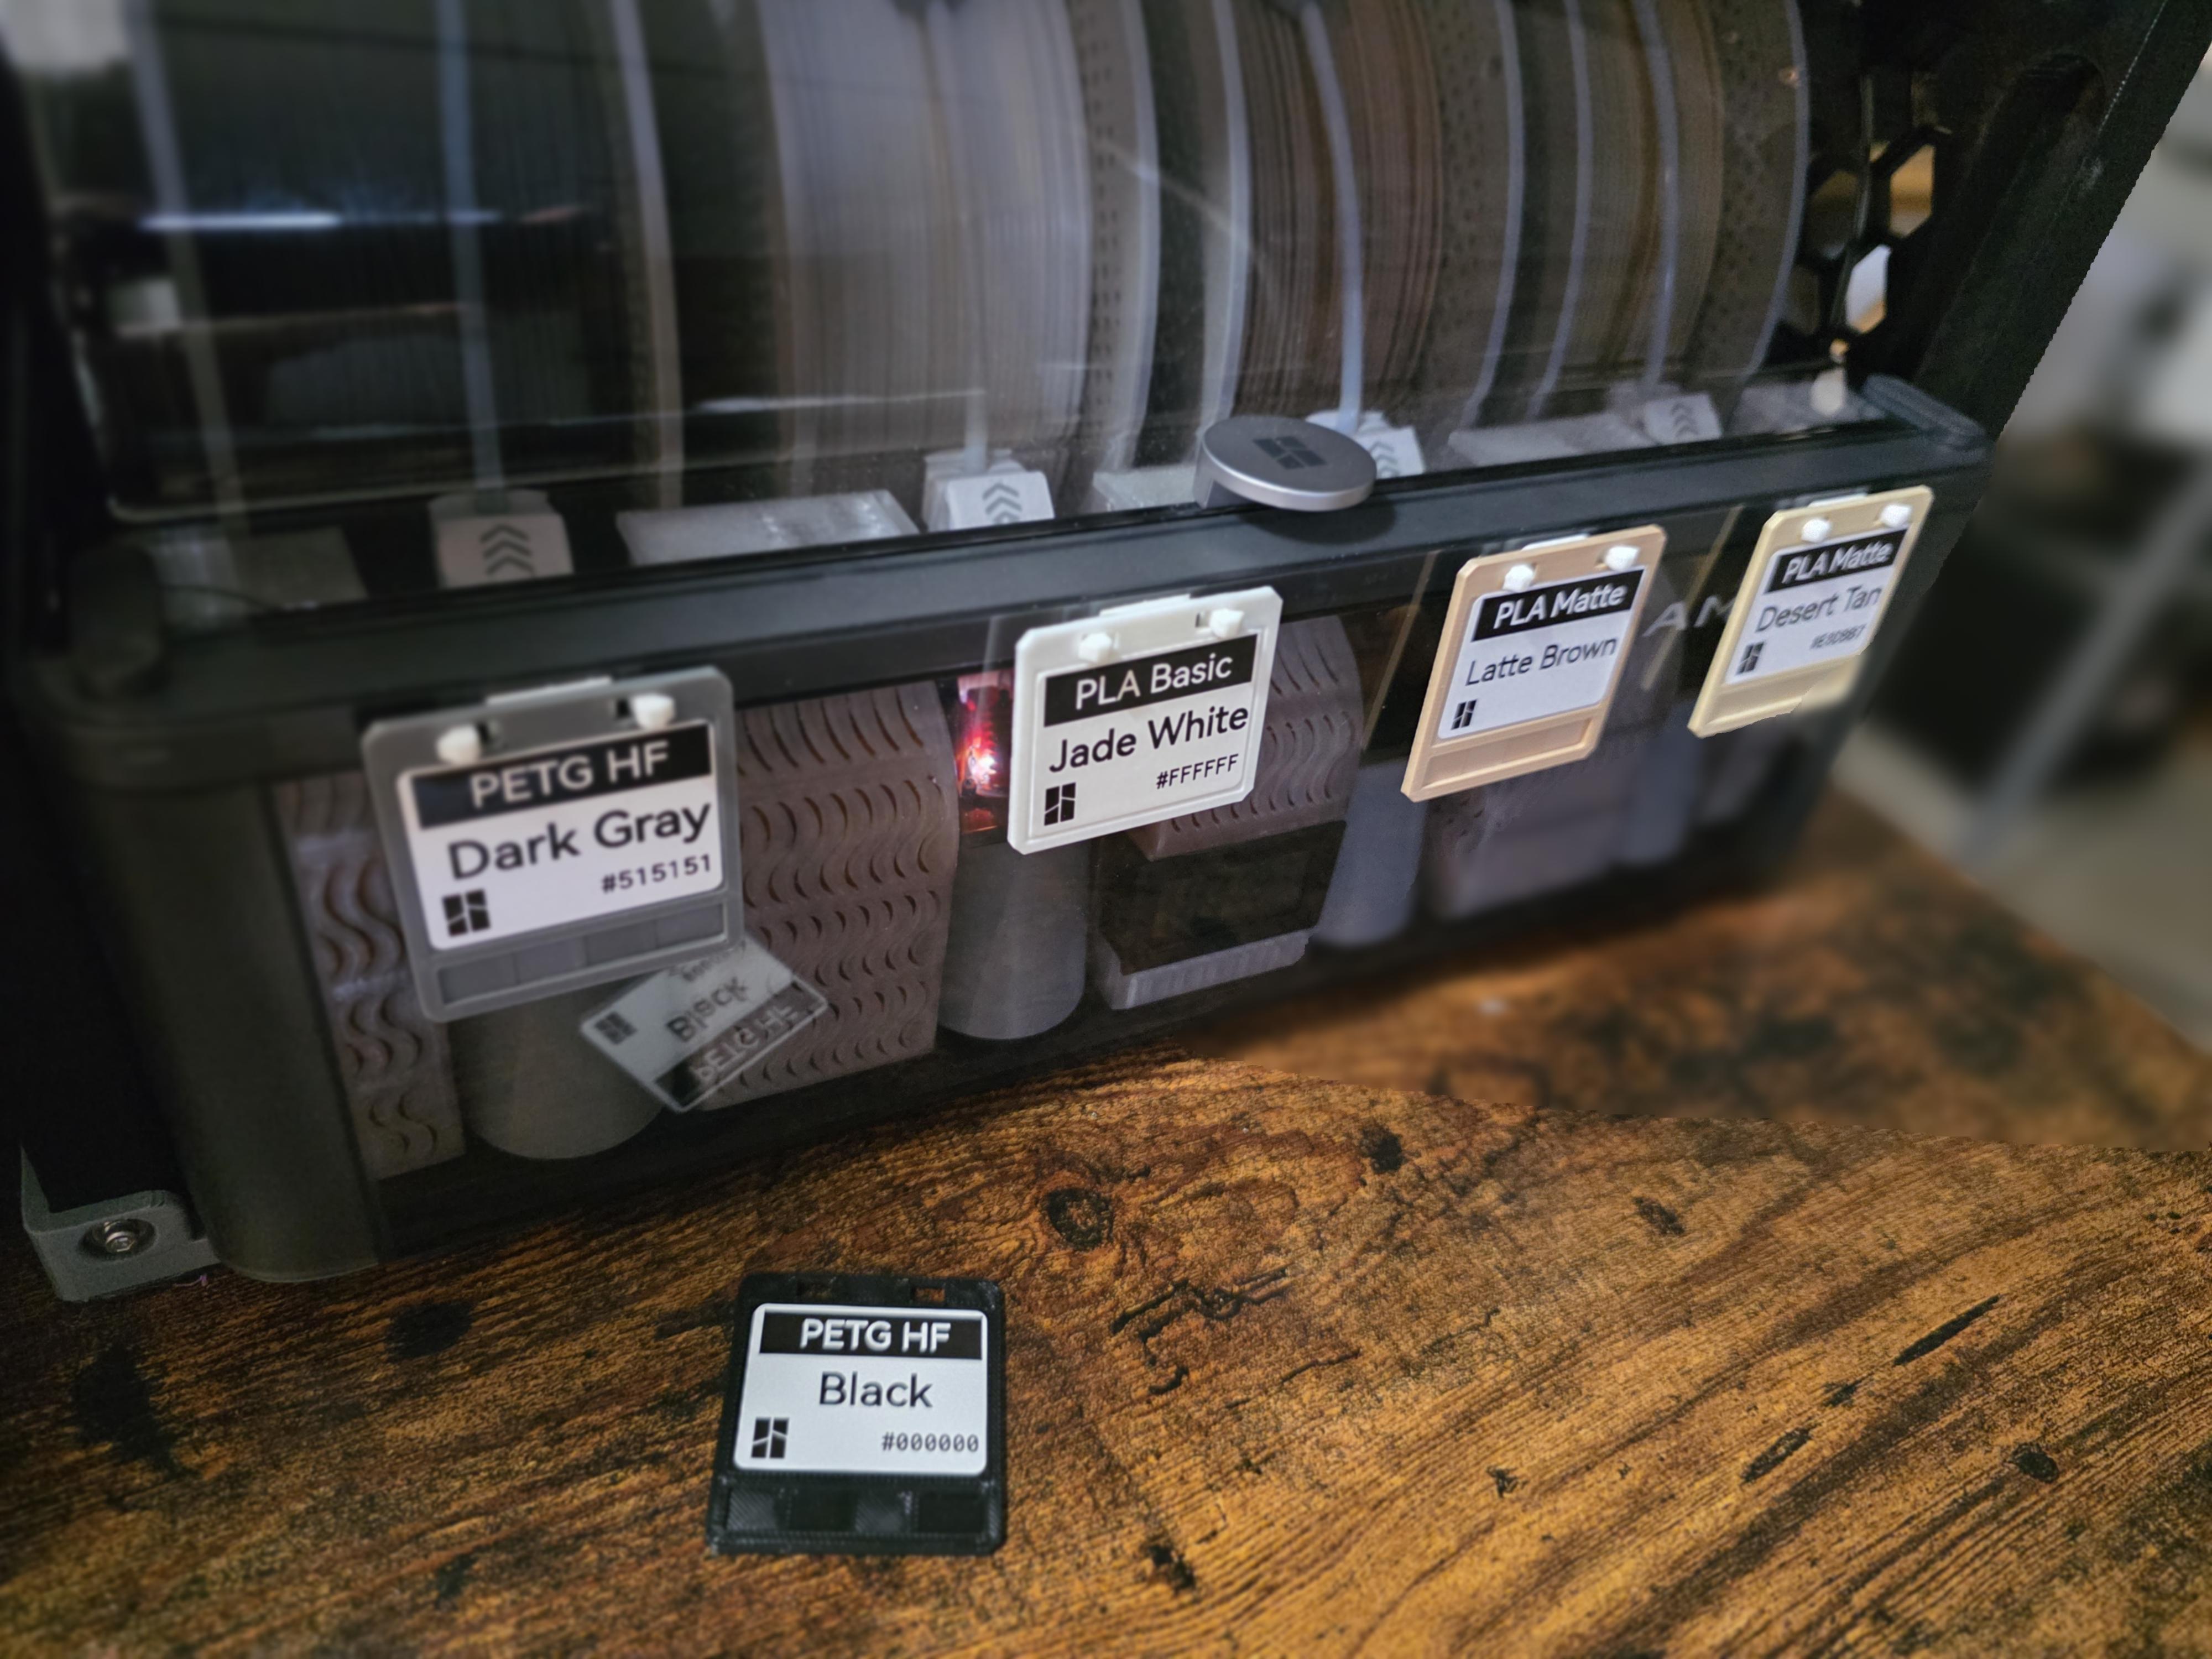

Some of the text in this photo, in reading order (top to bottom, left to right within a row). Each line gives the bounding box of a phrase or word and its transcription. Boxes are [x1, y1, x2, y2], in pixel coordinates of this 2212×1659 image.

[1782, 541, 1894, 584] PLA Matte
[1493, 583, 1627, 629] PLA Matte
[1755, 584, 1882, 633] Desert Tan
[1076, 653, 1233, 710] PLA Basic
[1465, 638, 1618, 686] Latte Brown
[1049, 706, 1248, 773] Jade White
[470, 741, 669, 808] PETG HF
[1156, 754, 1238, 789] #FFFFFF
[448, 803, 711, 881] Dark Gray
[601, 854, 711, 894] #515151
[800, 1318, 951, 1353] PETG HF
[819, 1371, 933, 1408] Black
[881, 1431, 979, 1452] #000000
